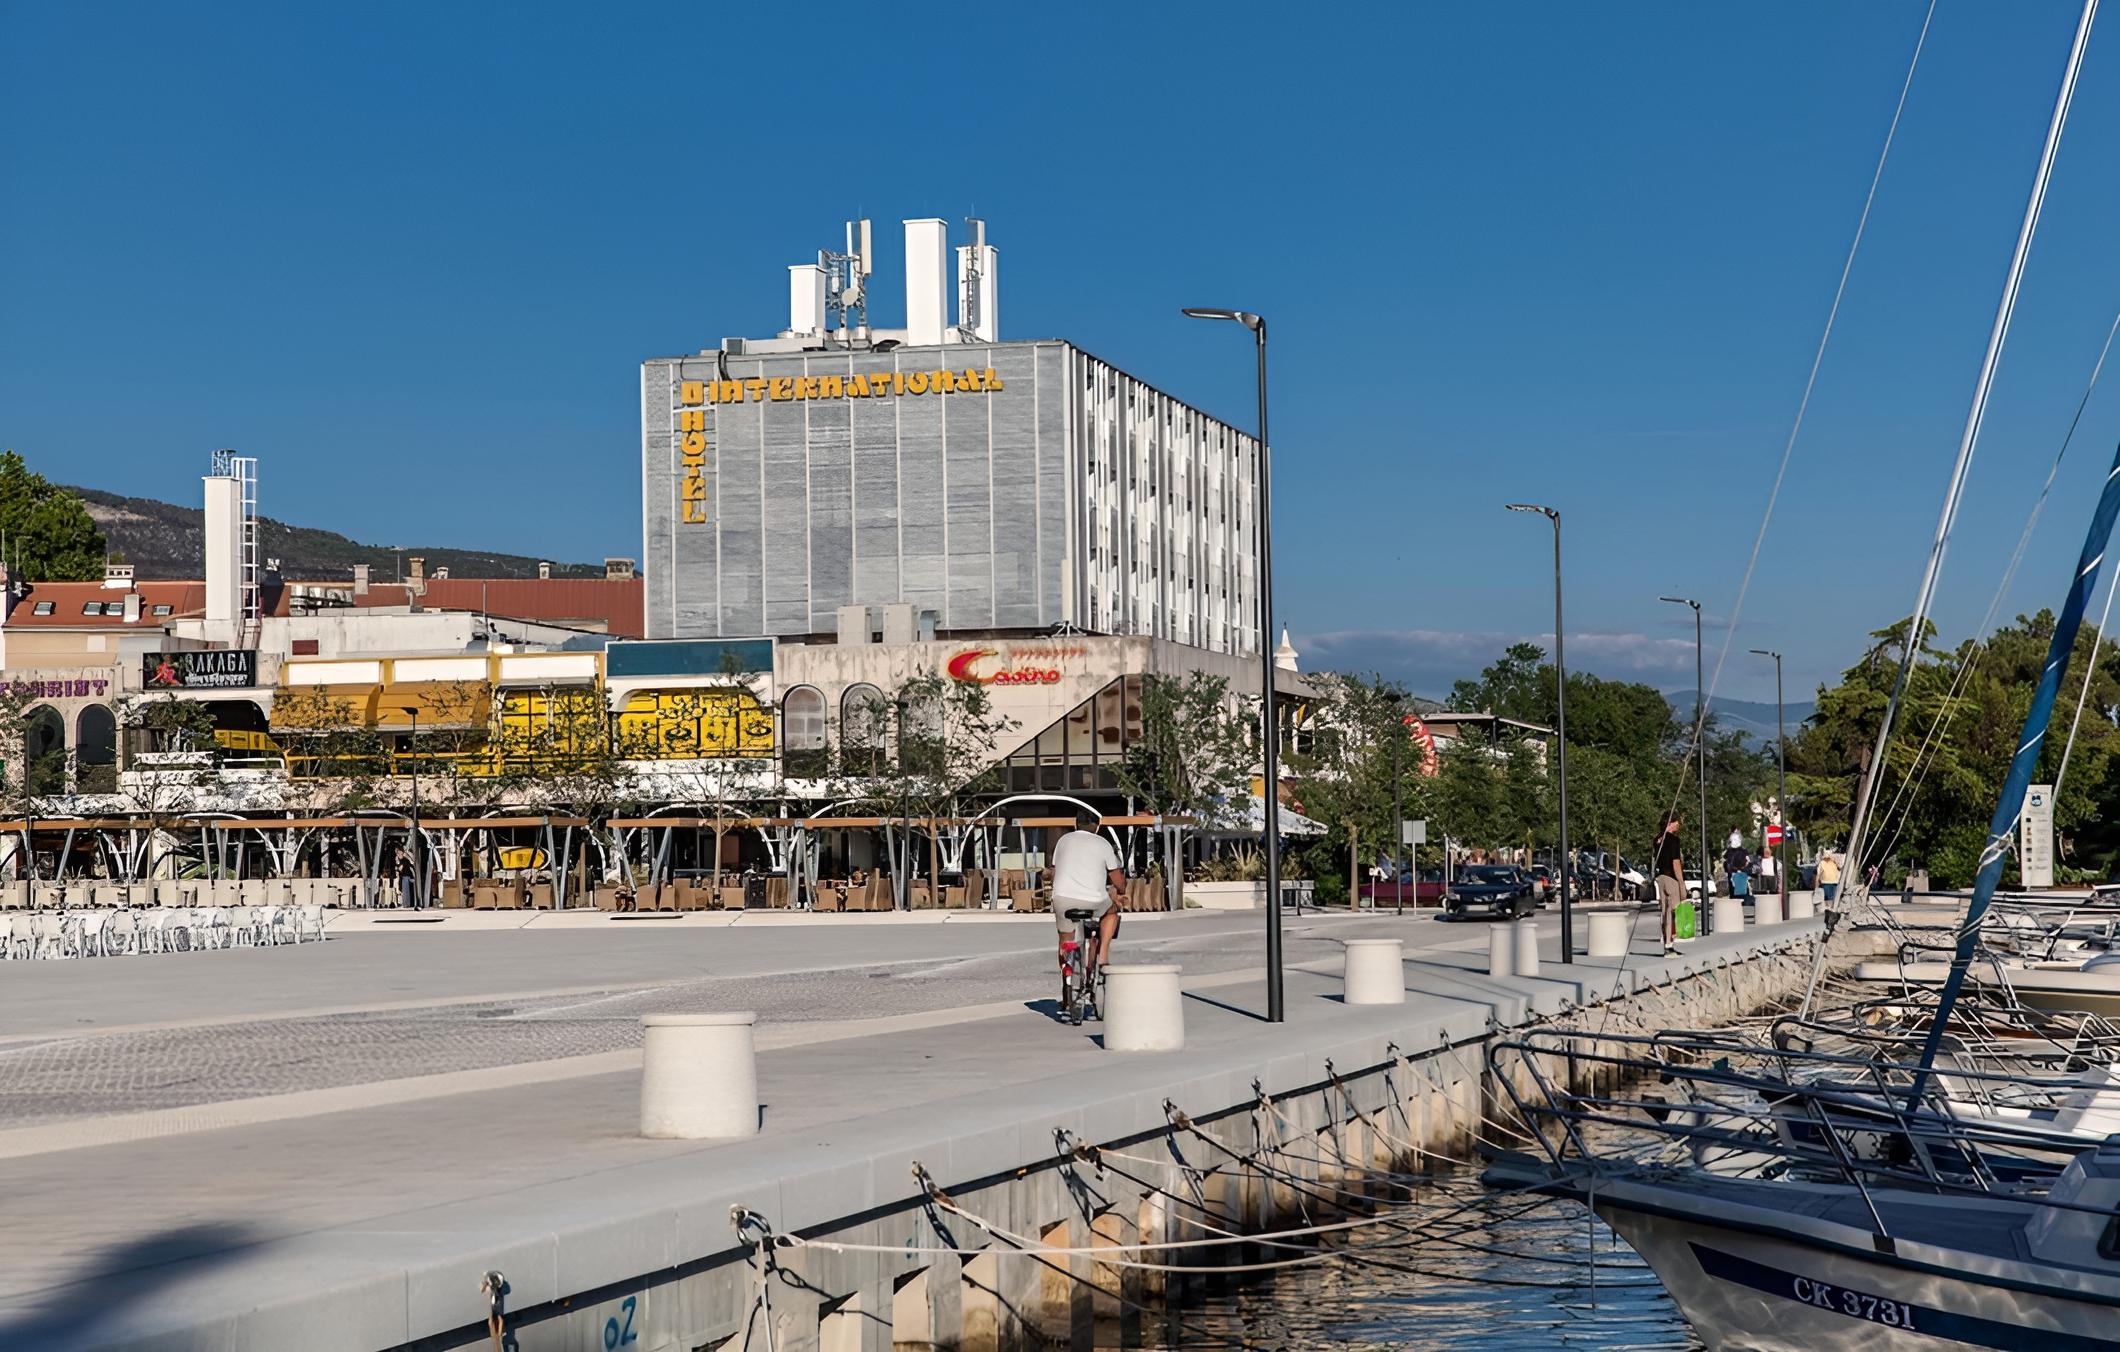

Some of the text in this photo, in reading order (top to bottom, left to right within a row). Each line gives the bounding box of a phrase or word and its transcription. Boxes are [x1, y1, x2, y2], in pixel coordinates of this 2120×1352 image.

[681, 410, 706, 523] HOTEL
[1793, 1277, 1916, 1330] CK 3731
